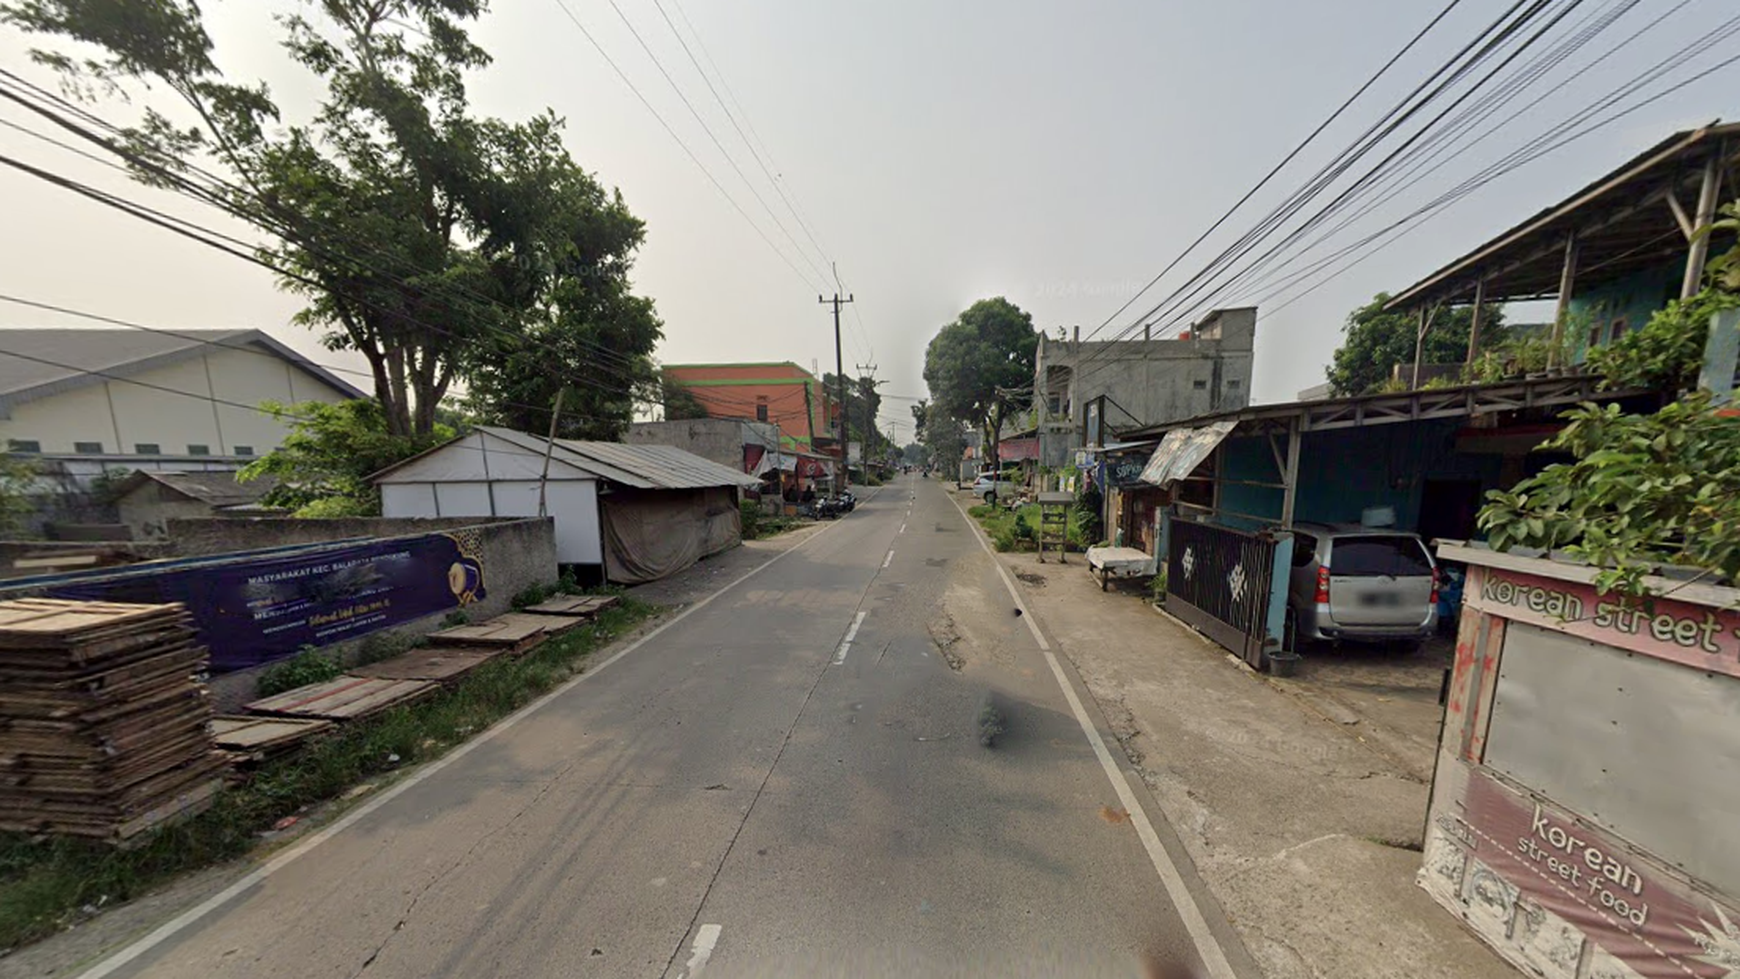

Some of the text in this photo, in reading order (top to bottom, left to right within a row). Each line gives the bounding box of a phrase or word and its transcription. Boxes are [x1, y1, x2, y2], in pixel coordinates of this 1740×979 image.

[247, 567, 311, 585] MASYARAKAT
[1481, 575, 1584, 622] korean
[1595, 596, 1722, 653] street
[1517, 835, 1648, 927] street food
[1531, 804, 1643, 896] korean
